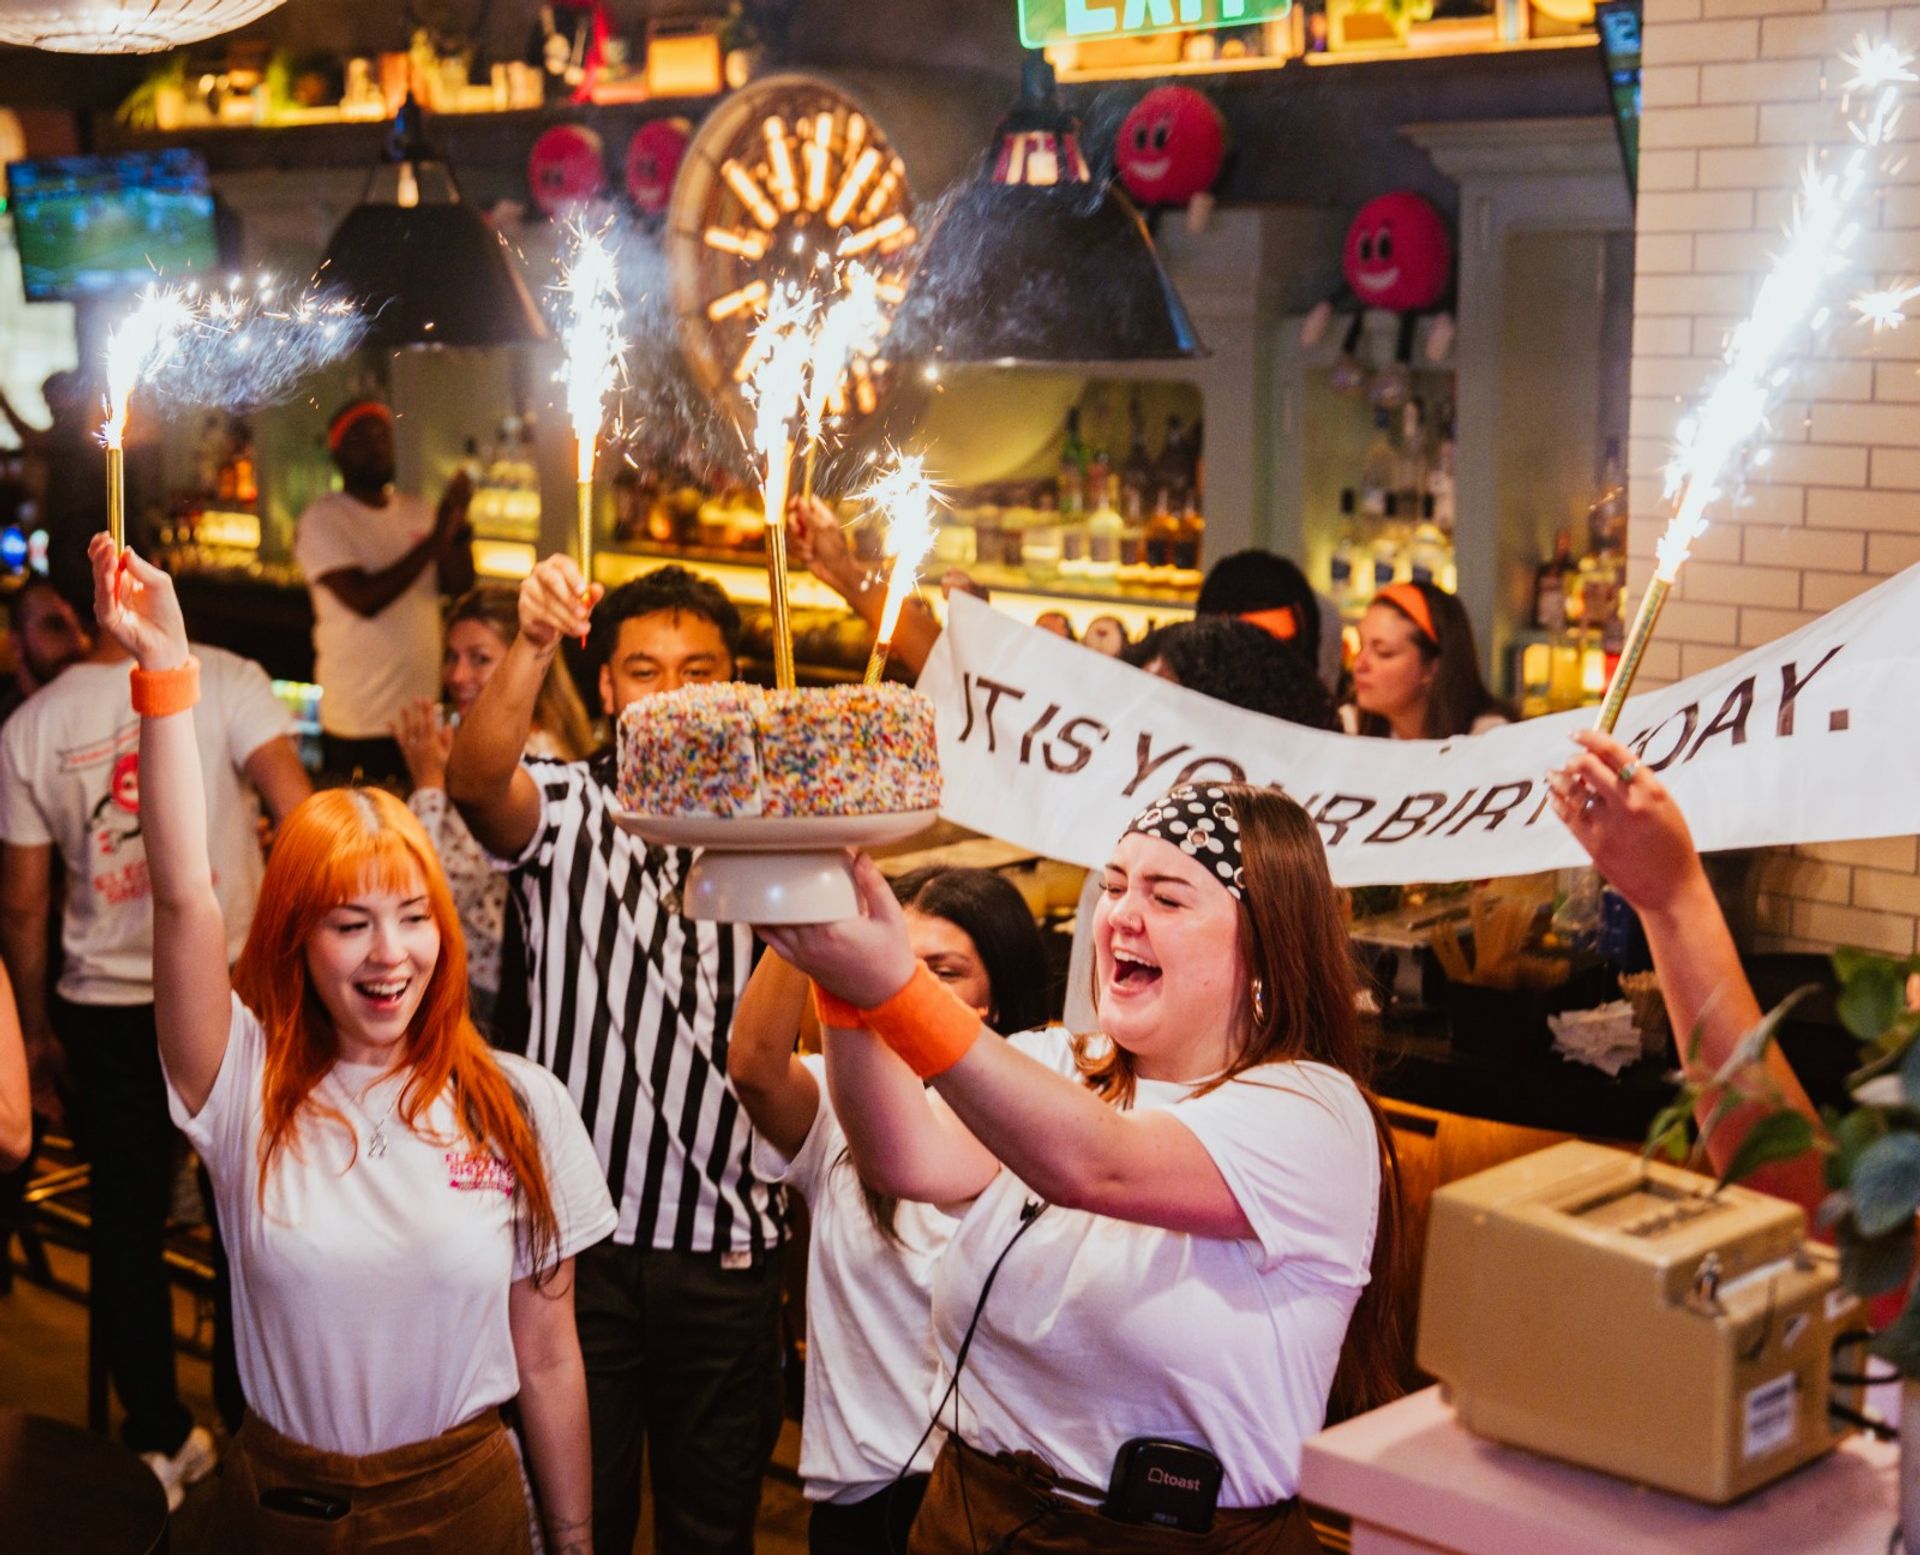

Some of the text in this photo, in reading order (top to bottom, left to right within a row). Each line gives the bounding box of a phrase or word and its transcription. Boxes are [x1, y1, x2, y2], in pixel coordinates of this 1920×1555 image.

[958, 672, 1026, 753] IT
[1019, 703, 1110, 775] IS
[1164, 1472, 1201, 1491] toast
